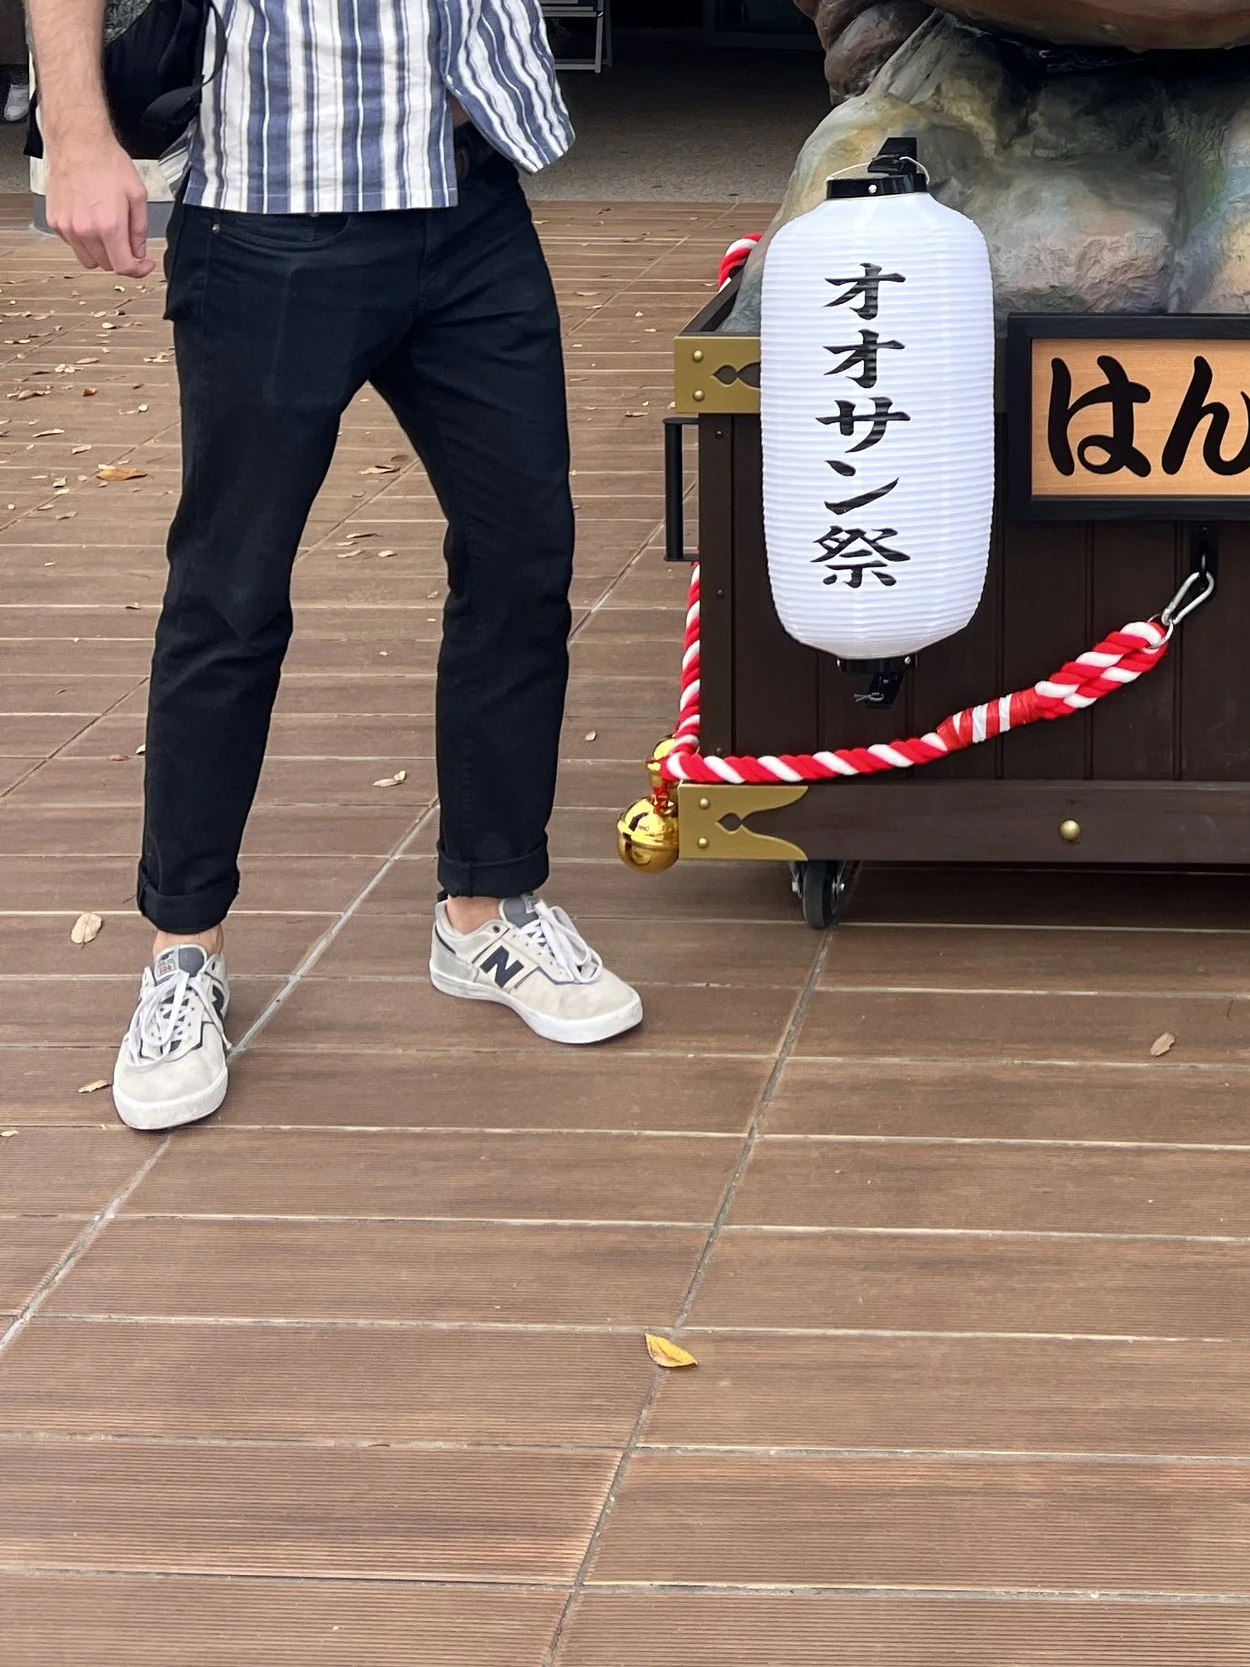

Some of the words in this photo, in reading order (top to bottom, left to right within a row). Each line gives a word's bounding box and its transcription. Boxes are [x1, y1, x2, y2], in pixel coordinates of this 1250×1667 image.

[810, 261, 912, 589] オオサン祭
[479, 945, 525, 989] N
